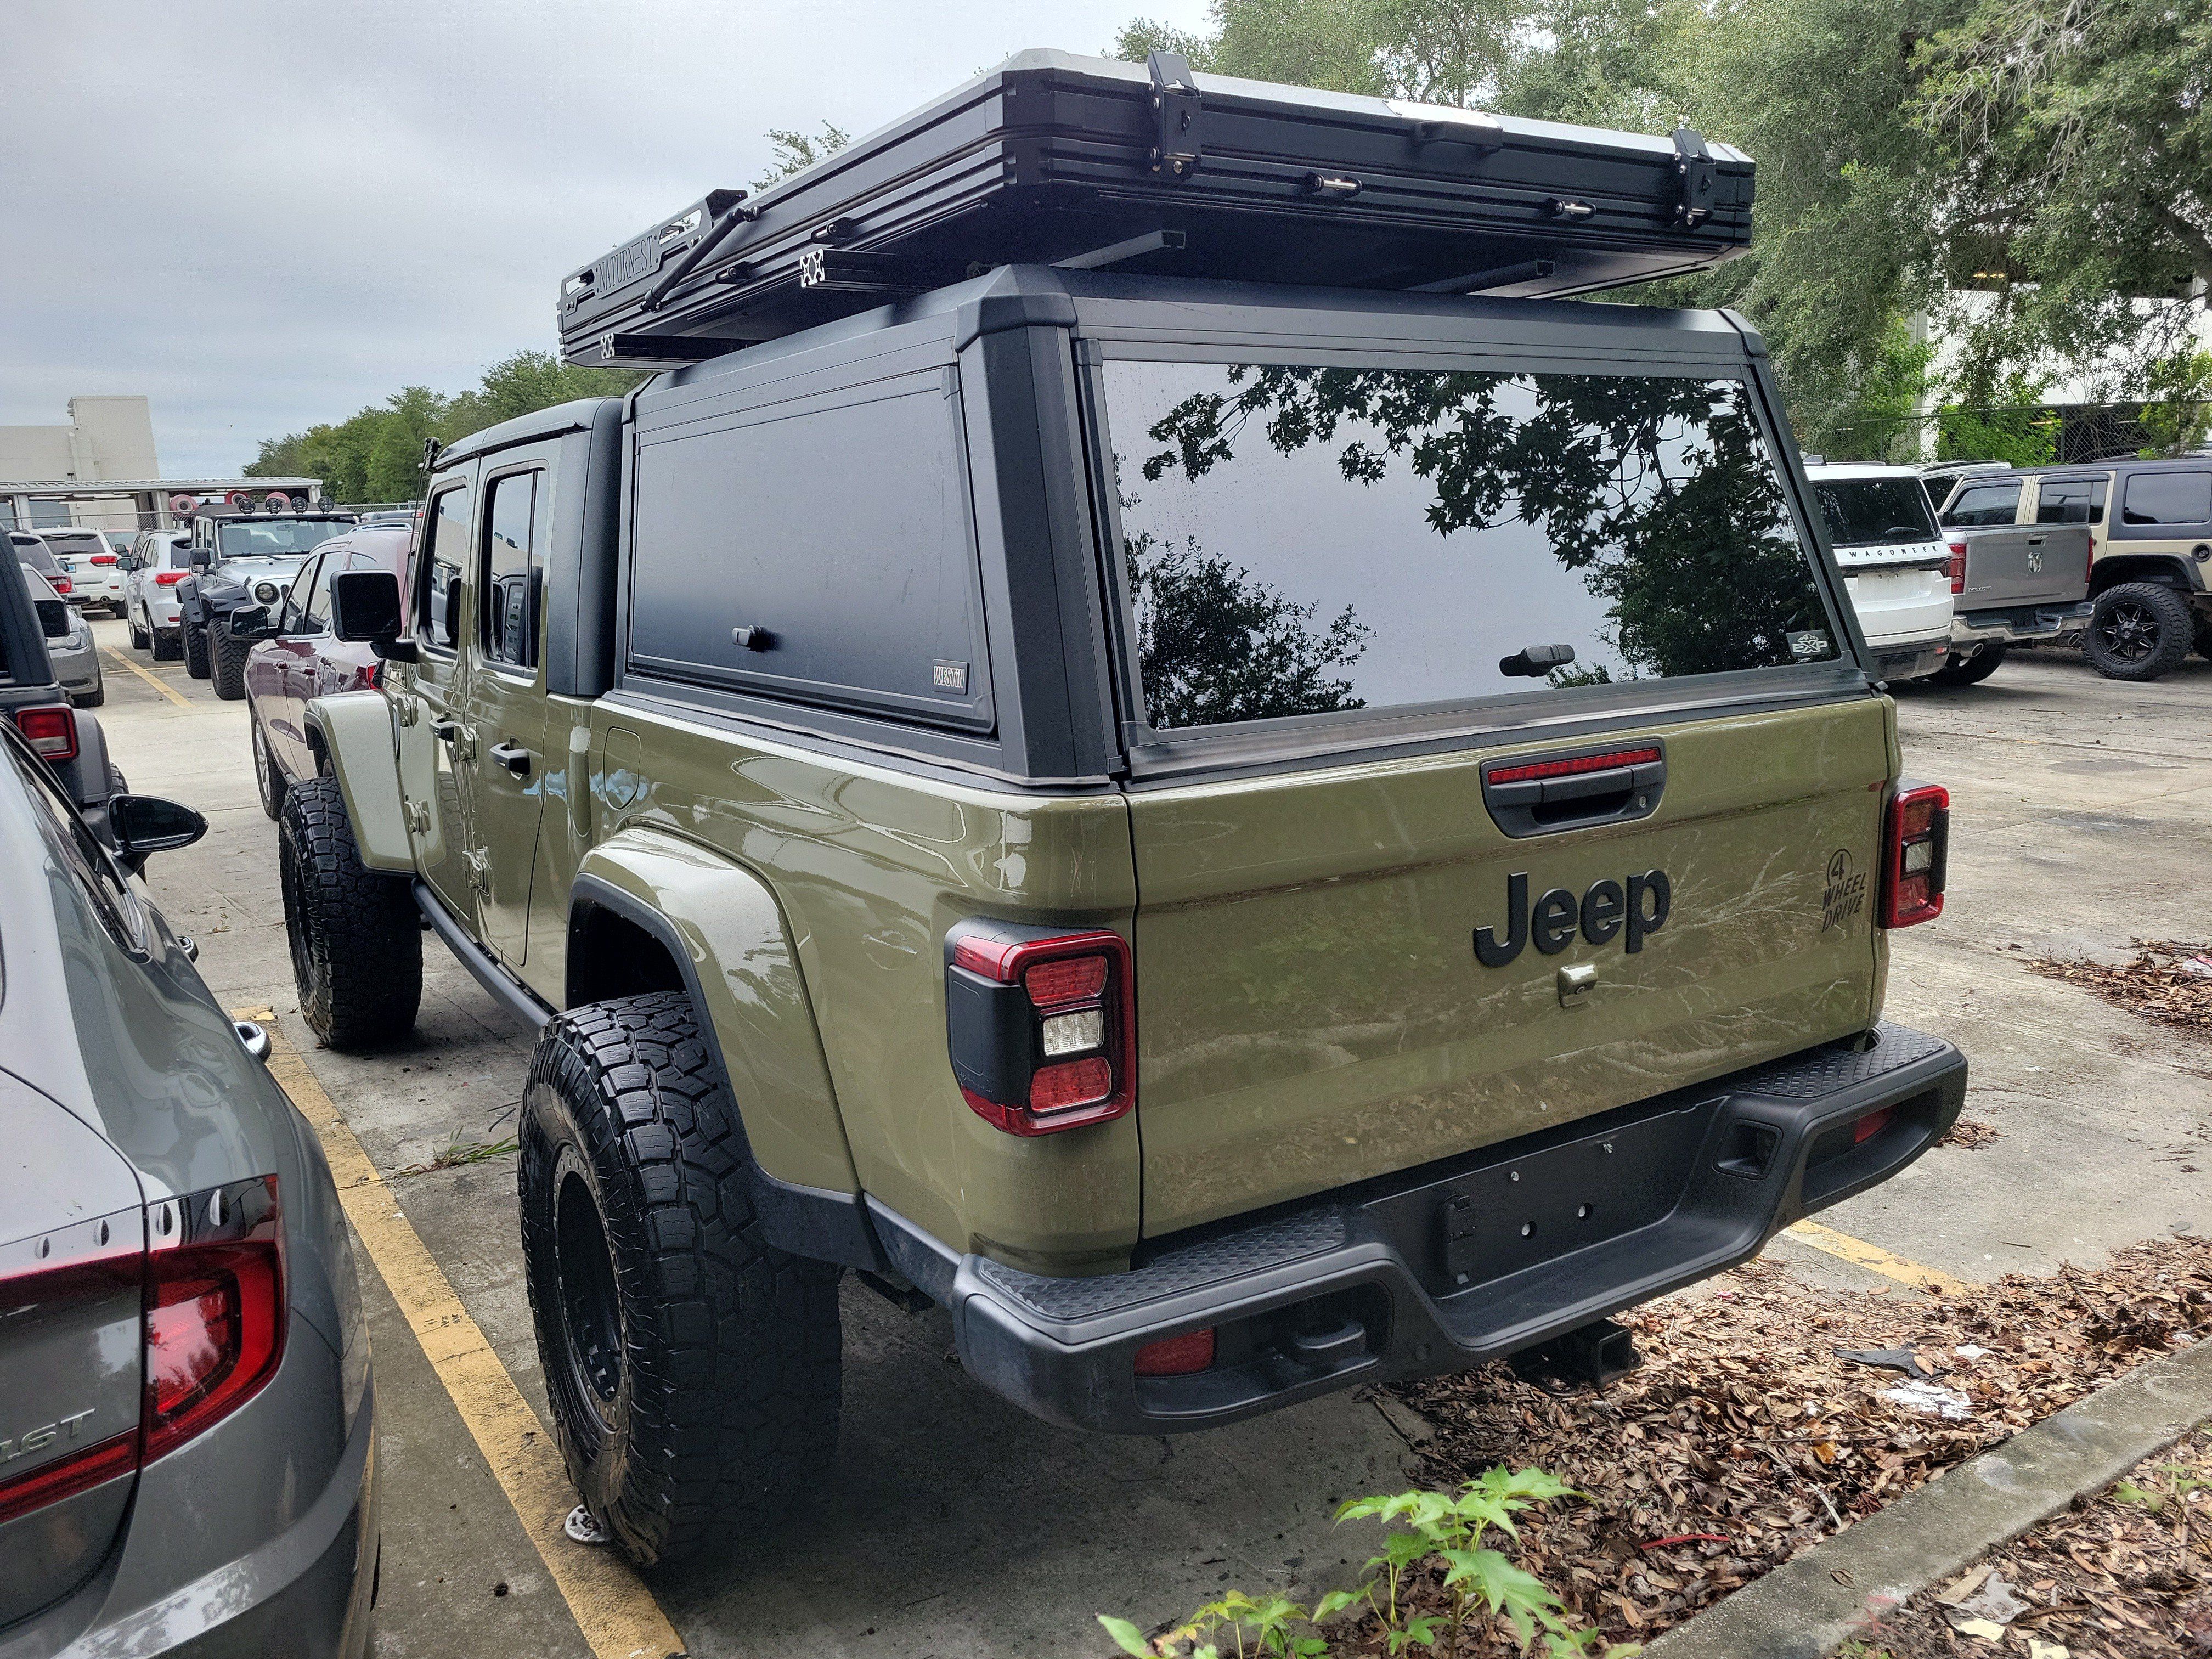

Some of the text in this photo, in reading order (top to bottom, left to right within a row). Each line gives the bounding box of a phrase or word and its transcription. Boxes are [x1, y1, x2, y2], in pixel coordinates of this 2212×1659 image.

[599, 235, 653, 293] NATURNEST
[1849, 545, 1937, 558] WAGONEER
[1792, 639, 1827, 654] EXP
[1822, 872, 1867, 911] WHEEL
[1474, 869, 1671, 968] Jeep
[1822, 894, 1865, 933] DRIVE
